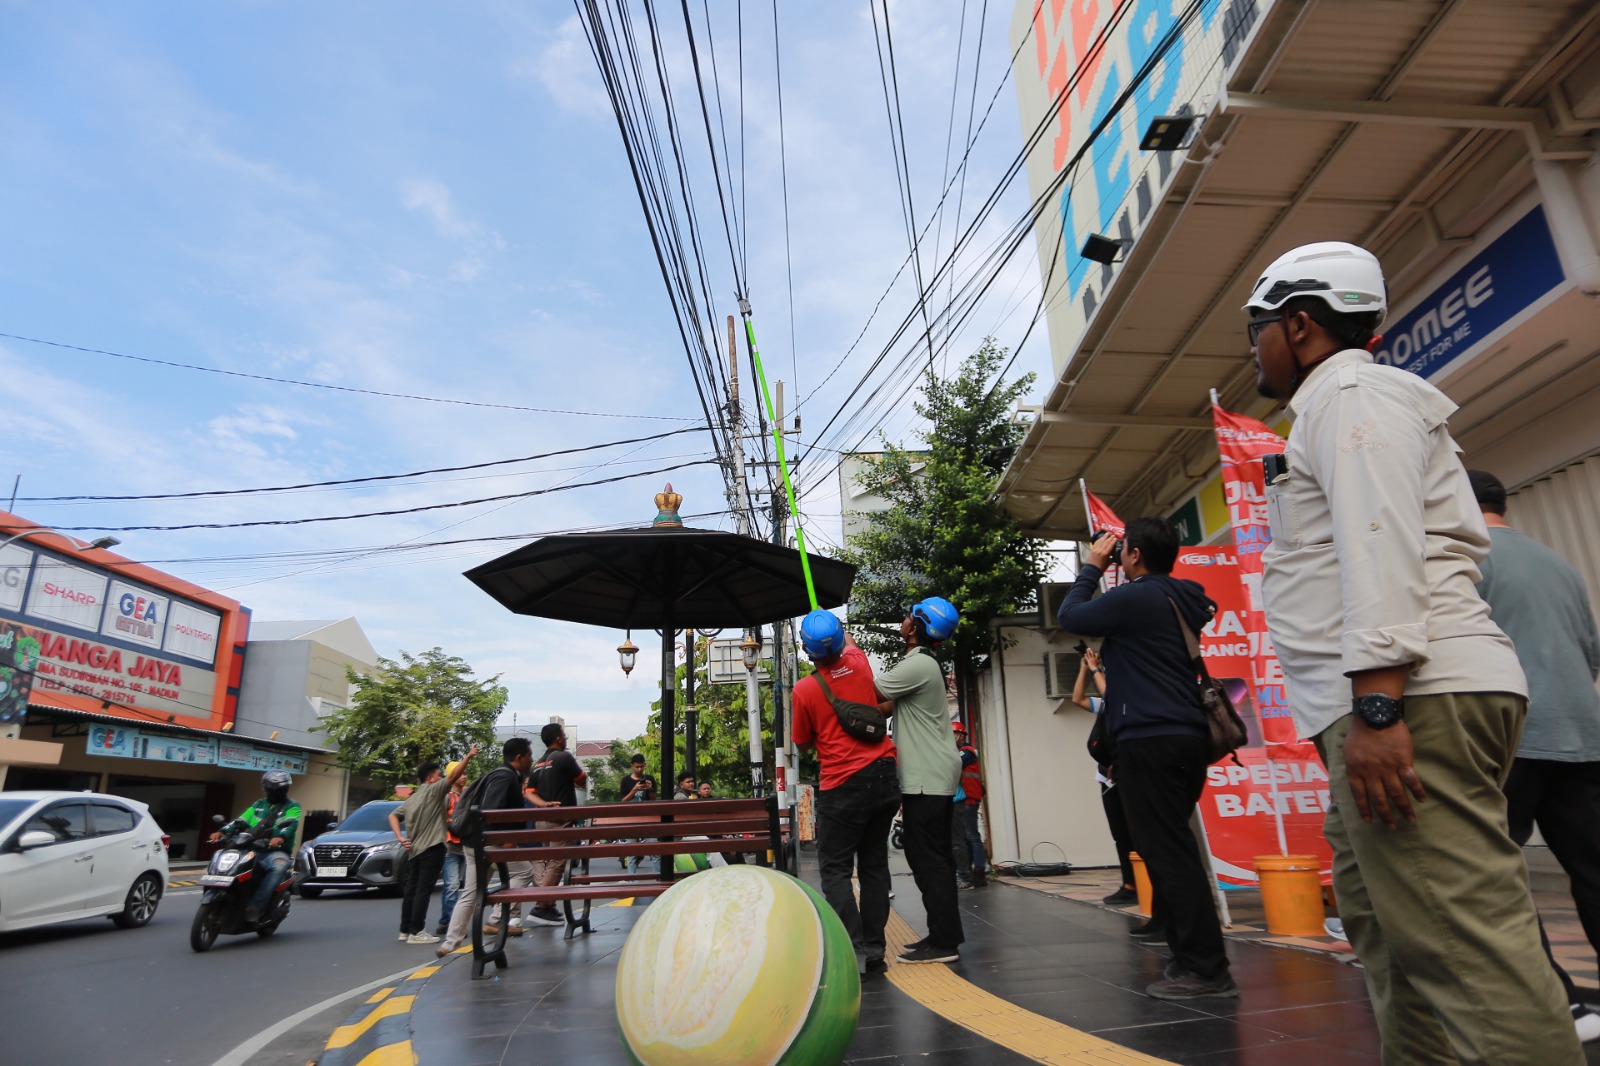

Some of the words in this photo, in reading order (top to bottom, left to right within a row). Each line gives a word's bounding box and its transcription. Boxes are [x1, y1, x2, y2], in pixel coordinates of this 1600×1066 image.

[1405, 352, 1430, 374] EST
[1429, 336, 1453, 361] FOR
[1453, 321, 1473, 344] ME
[43, 582, 97, 607] SHARP
[119, 592, 158, 625] GEA
[128, 655, 182, 686] JAYA
[149, 685, 179, 700] MADIUN
[92, 728, 126, 750] GEA
